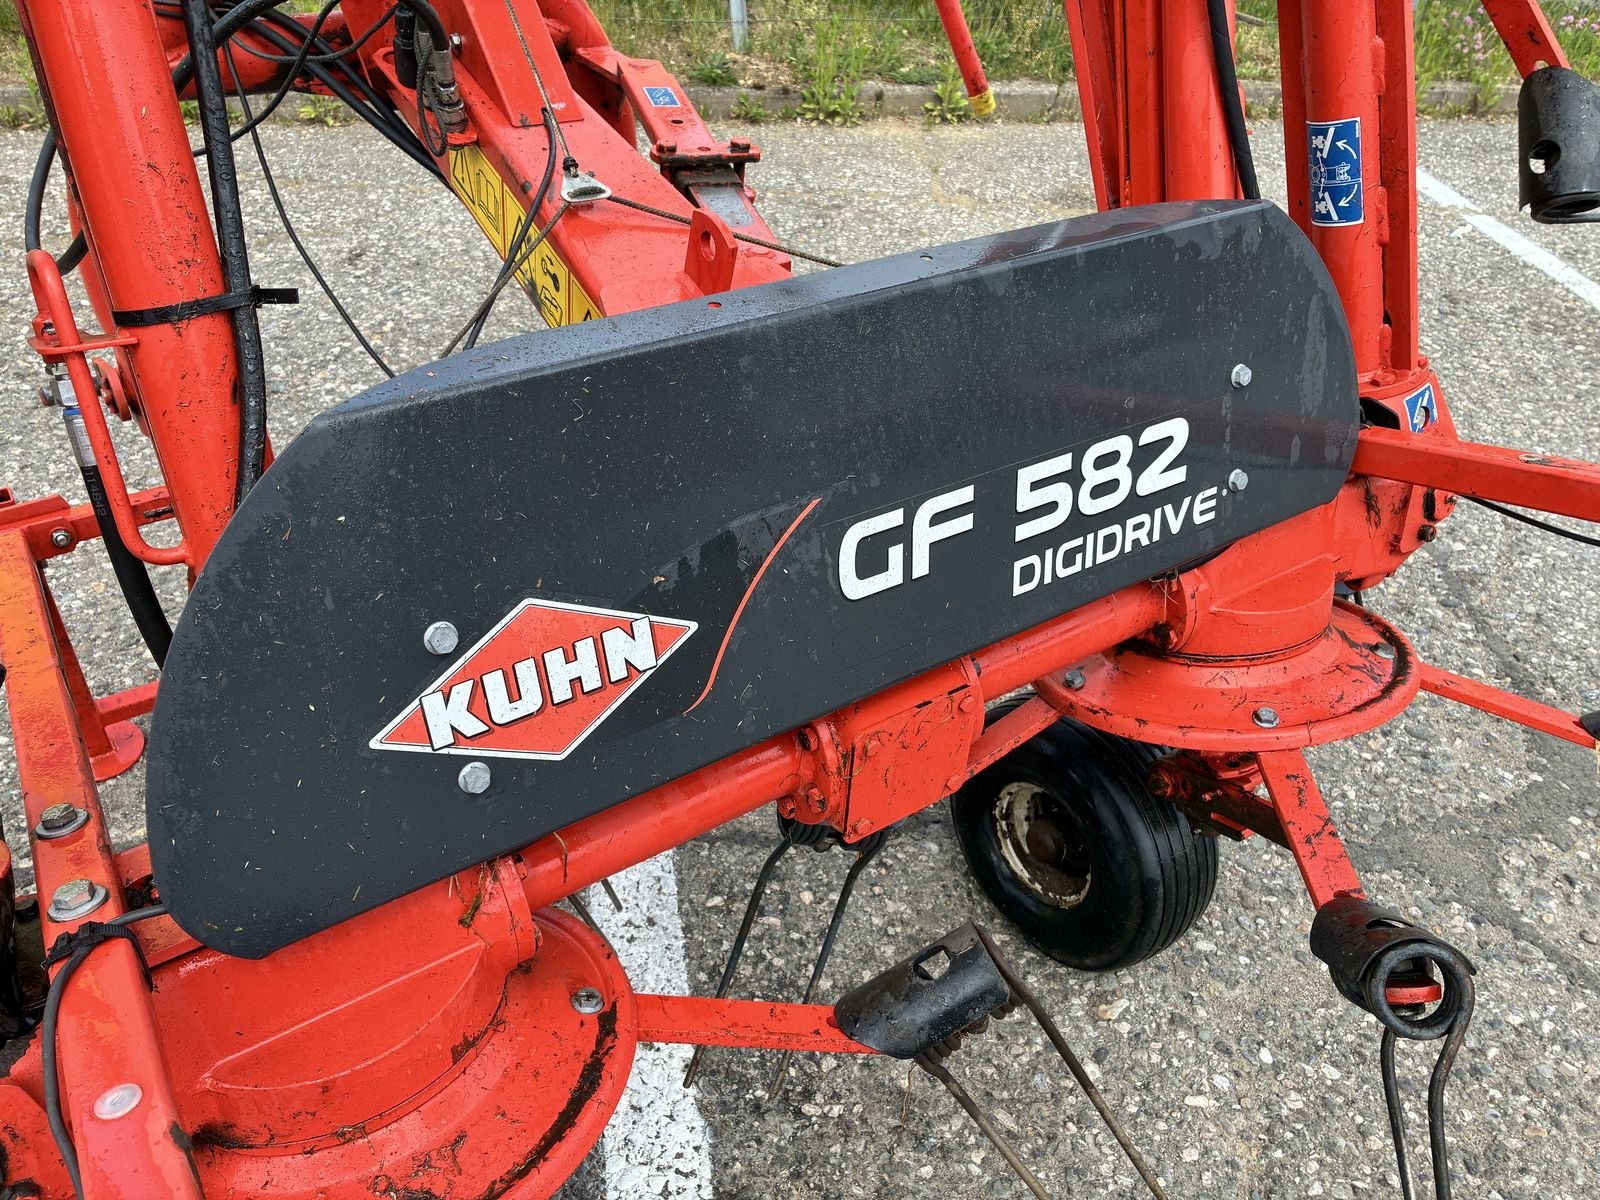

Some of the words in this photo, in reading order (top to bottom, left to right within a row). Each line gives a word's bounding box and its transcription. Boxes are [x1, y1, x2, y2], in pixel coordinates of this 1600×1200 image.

[838, 484, 975, 601] GF
[1014, 416, 1190, 543] 582
[1012, 485, 1219, 598] DIGIDRIVE
[419, 615, 659, 752] KUHN
